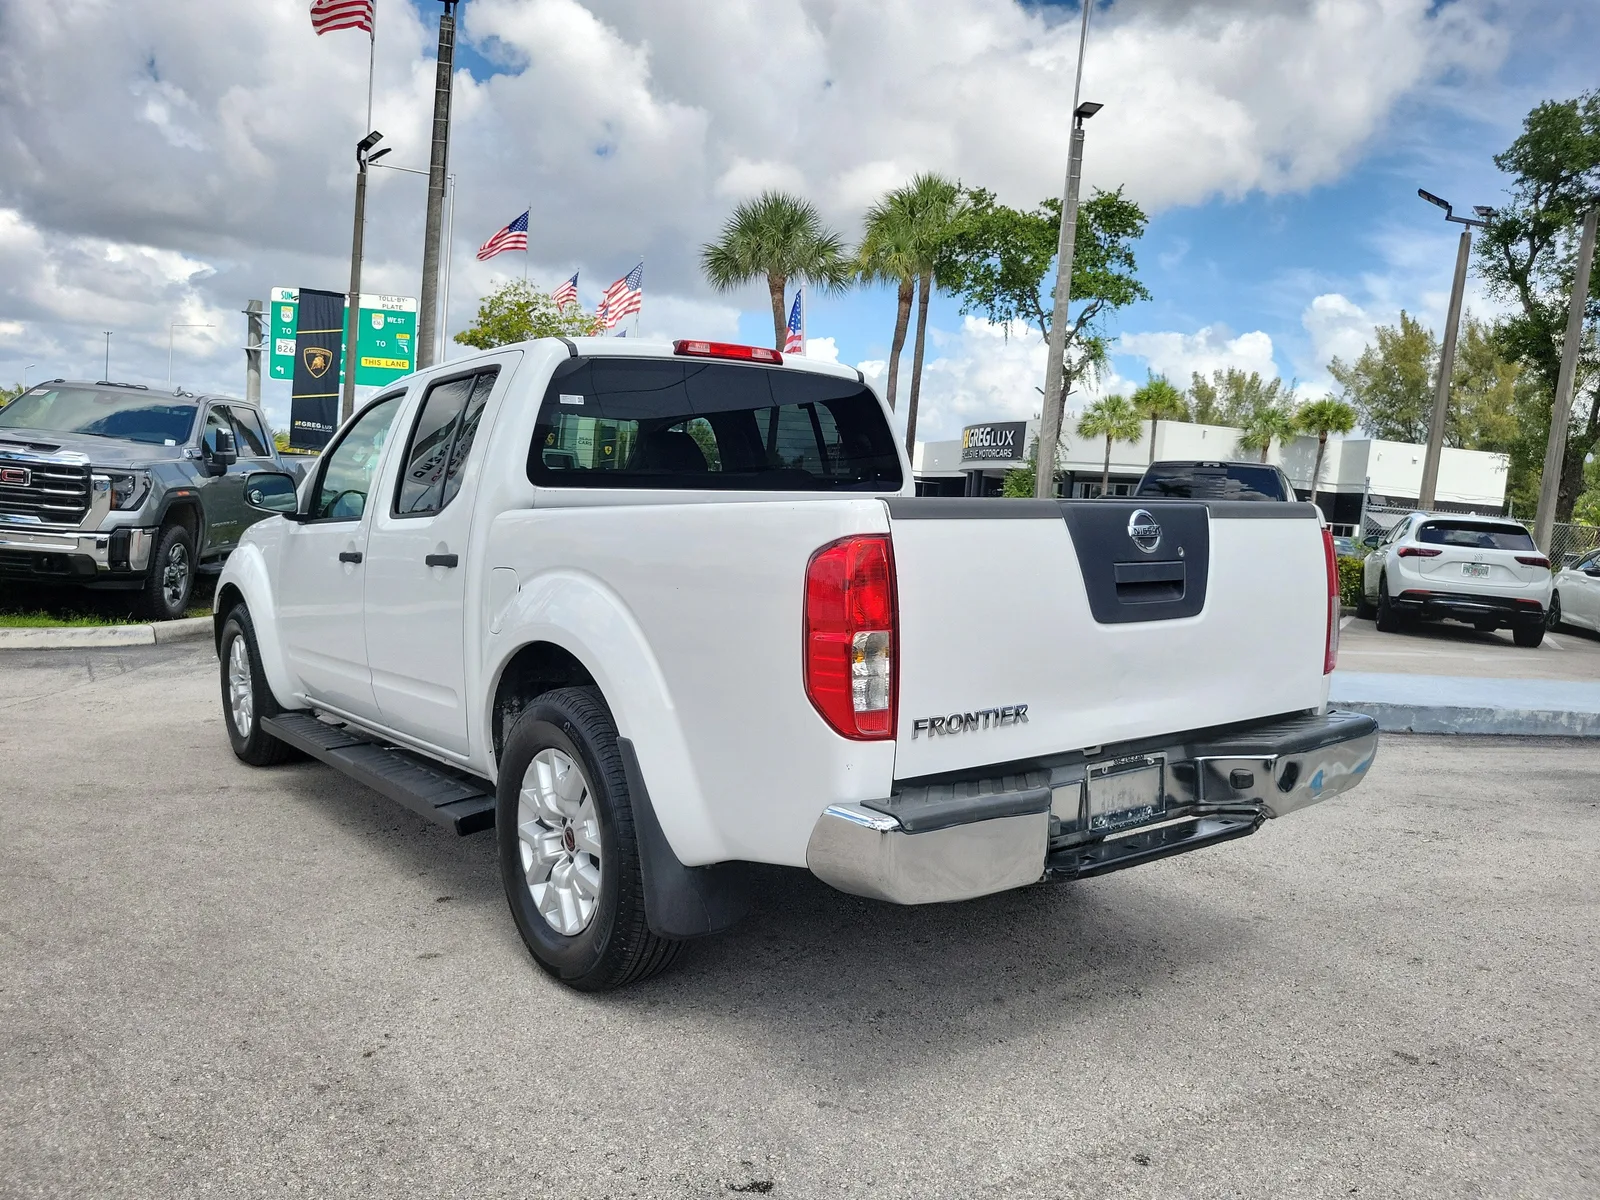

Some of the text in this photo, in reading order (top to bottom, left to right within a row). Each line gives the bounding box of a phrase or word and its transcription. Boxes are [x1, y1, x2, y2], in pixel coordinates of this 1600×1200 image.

[378, 295, 408, 303] TOLL-BY-
[387, 316, 405, 324] WEST
[281, 327, 292, 335] TO
[376, 340, 386, 348] TO
[277, 344, 294, 354] 826
[364, 358, 407, 368] THIS LANE
[979, 448, 1013, 458] MOTORCARS
[911, 703, 1029, 740] FRONTIER
